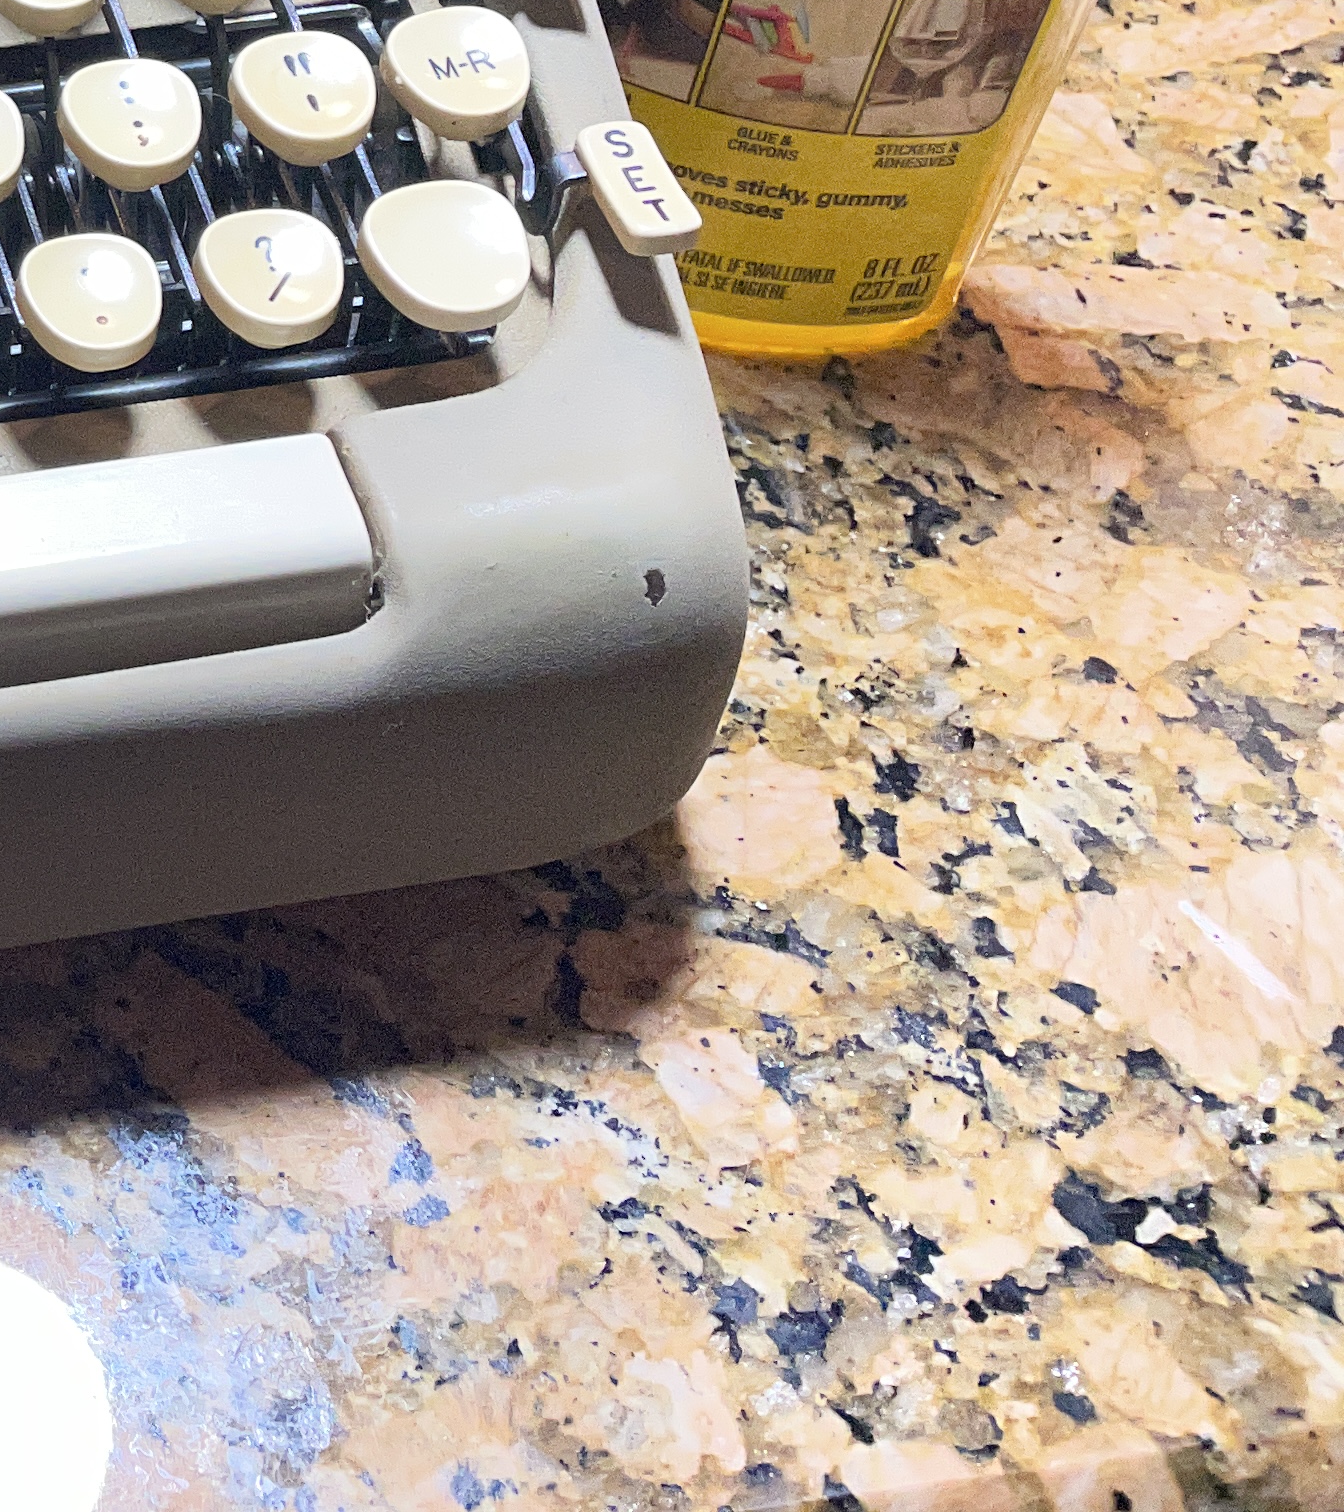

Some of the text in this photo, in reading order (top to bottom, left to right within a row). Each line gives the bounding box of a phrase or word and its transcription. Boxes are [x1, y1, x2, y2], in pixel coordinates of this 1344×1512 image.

[427, 48, 497, 80] M-R
[727, 139, 799, 162] CRAYONS
[873, 155, 956, 169] ADHESIVES
[874, 142, 948, 157] STICKERS
[603, 129, 672, 223] SET
[692, 190, 785, 220] messes
[735, 178, 810, 206] sticky,
[816, 190, 908, 210] gummy,
[682, 250, 723, 270] FATAL
[743, 260, 836, 284] SWALLOWED
[864, 259, 879, 279] 8
[911, 253, 940, 274] OZ
[849, 279, 896, 304] (237
